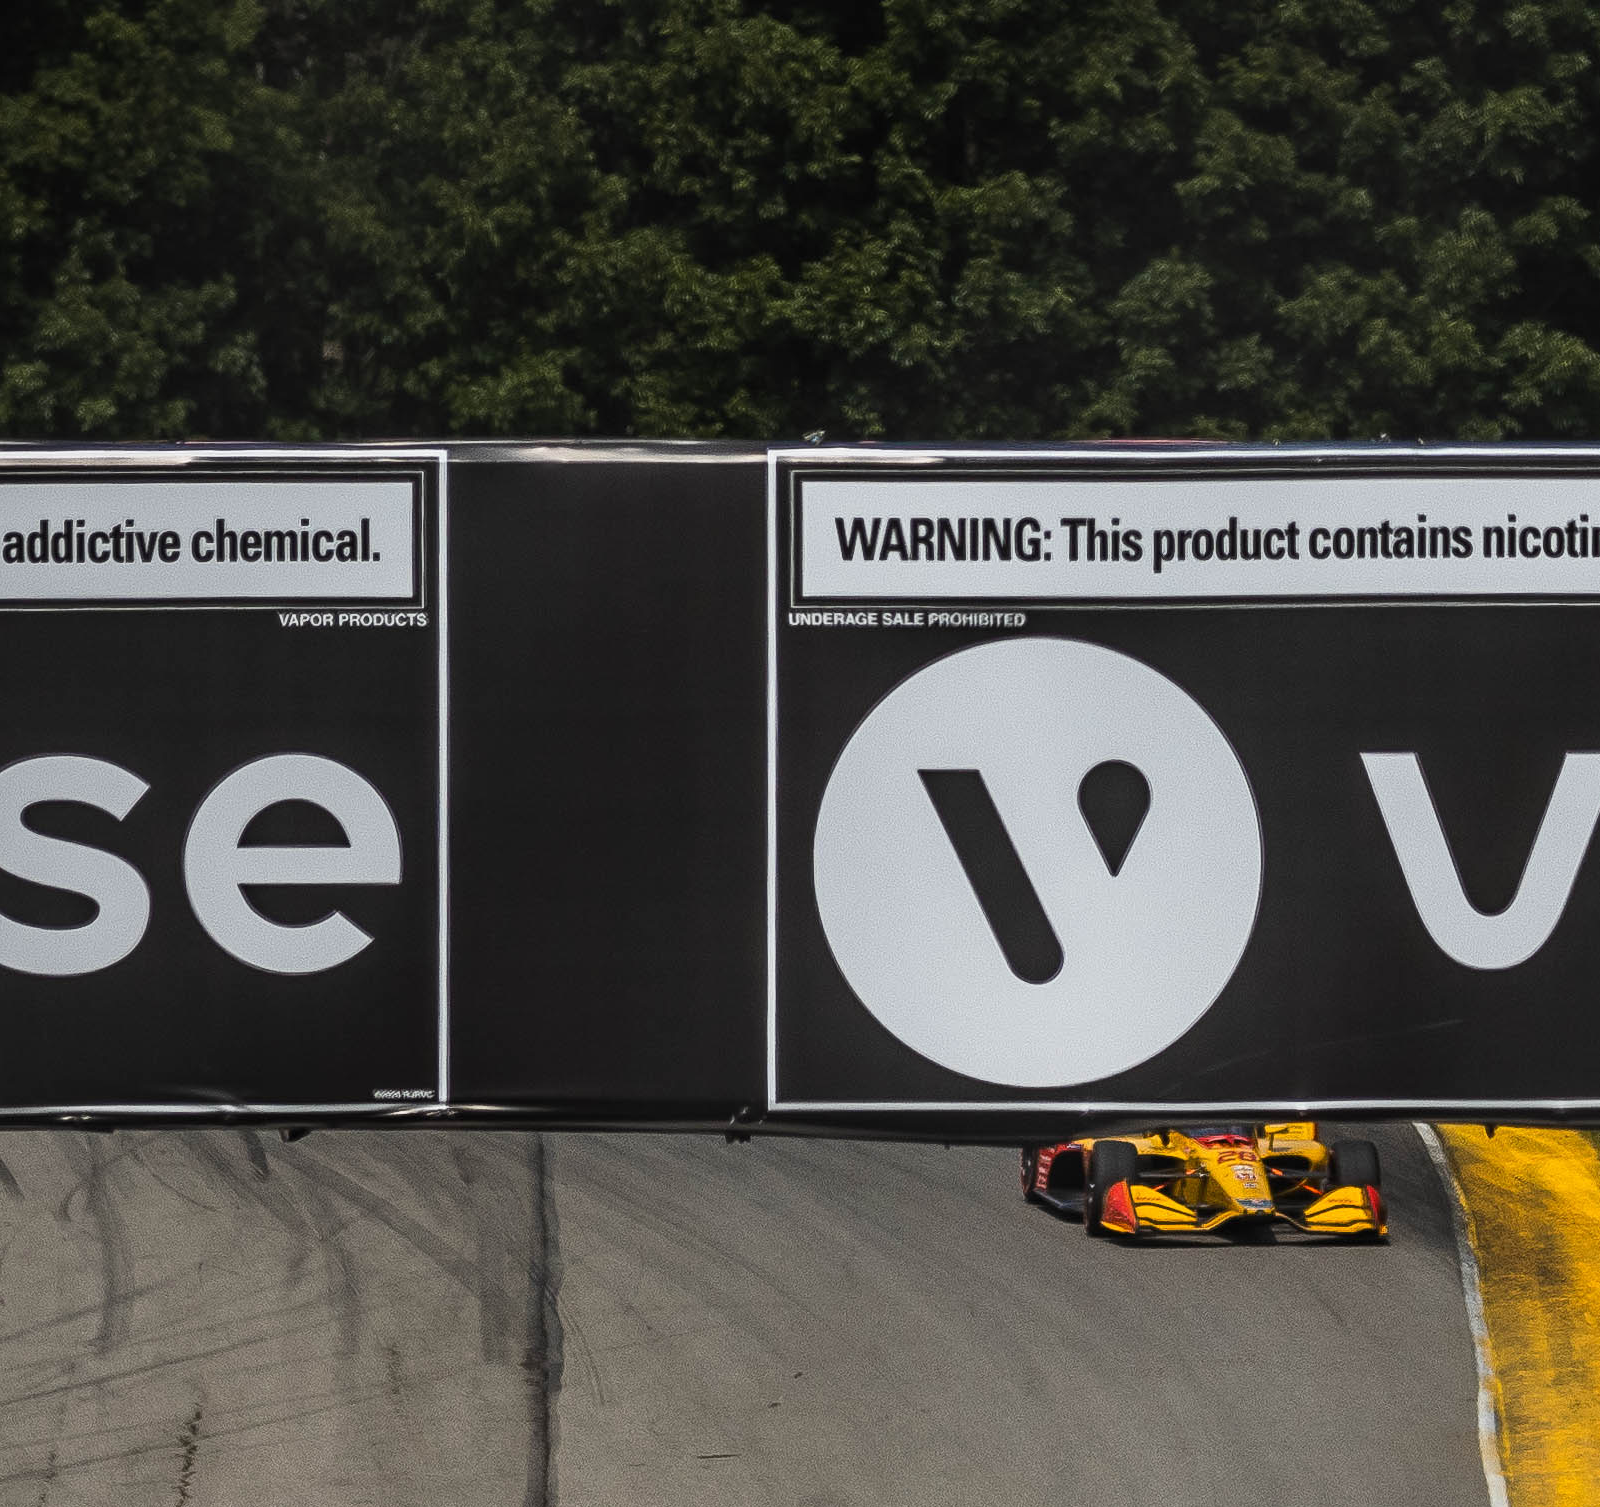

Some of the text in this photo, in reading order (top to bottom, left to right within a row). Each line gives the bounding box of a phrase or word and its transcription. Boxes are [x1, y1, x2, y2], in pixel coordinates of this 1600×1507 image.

[3, 520, 180, 563] addictive
[192, 519, 380, 562] chemical.
[835, 518, 1051, 561] WARNING:
[1061, 518, 1142, 561] This
[1154, 517, 1299, 573] product
[1309, 515, 1472, 559] contains
[278, 613, 428, 627] VAPOR PRODUCTS
[788, 612, 1027, 627] UNDERAGE SALE PROHIBITED
